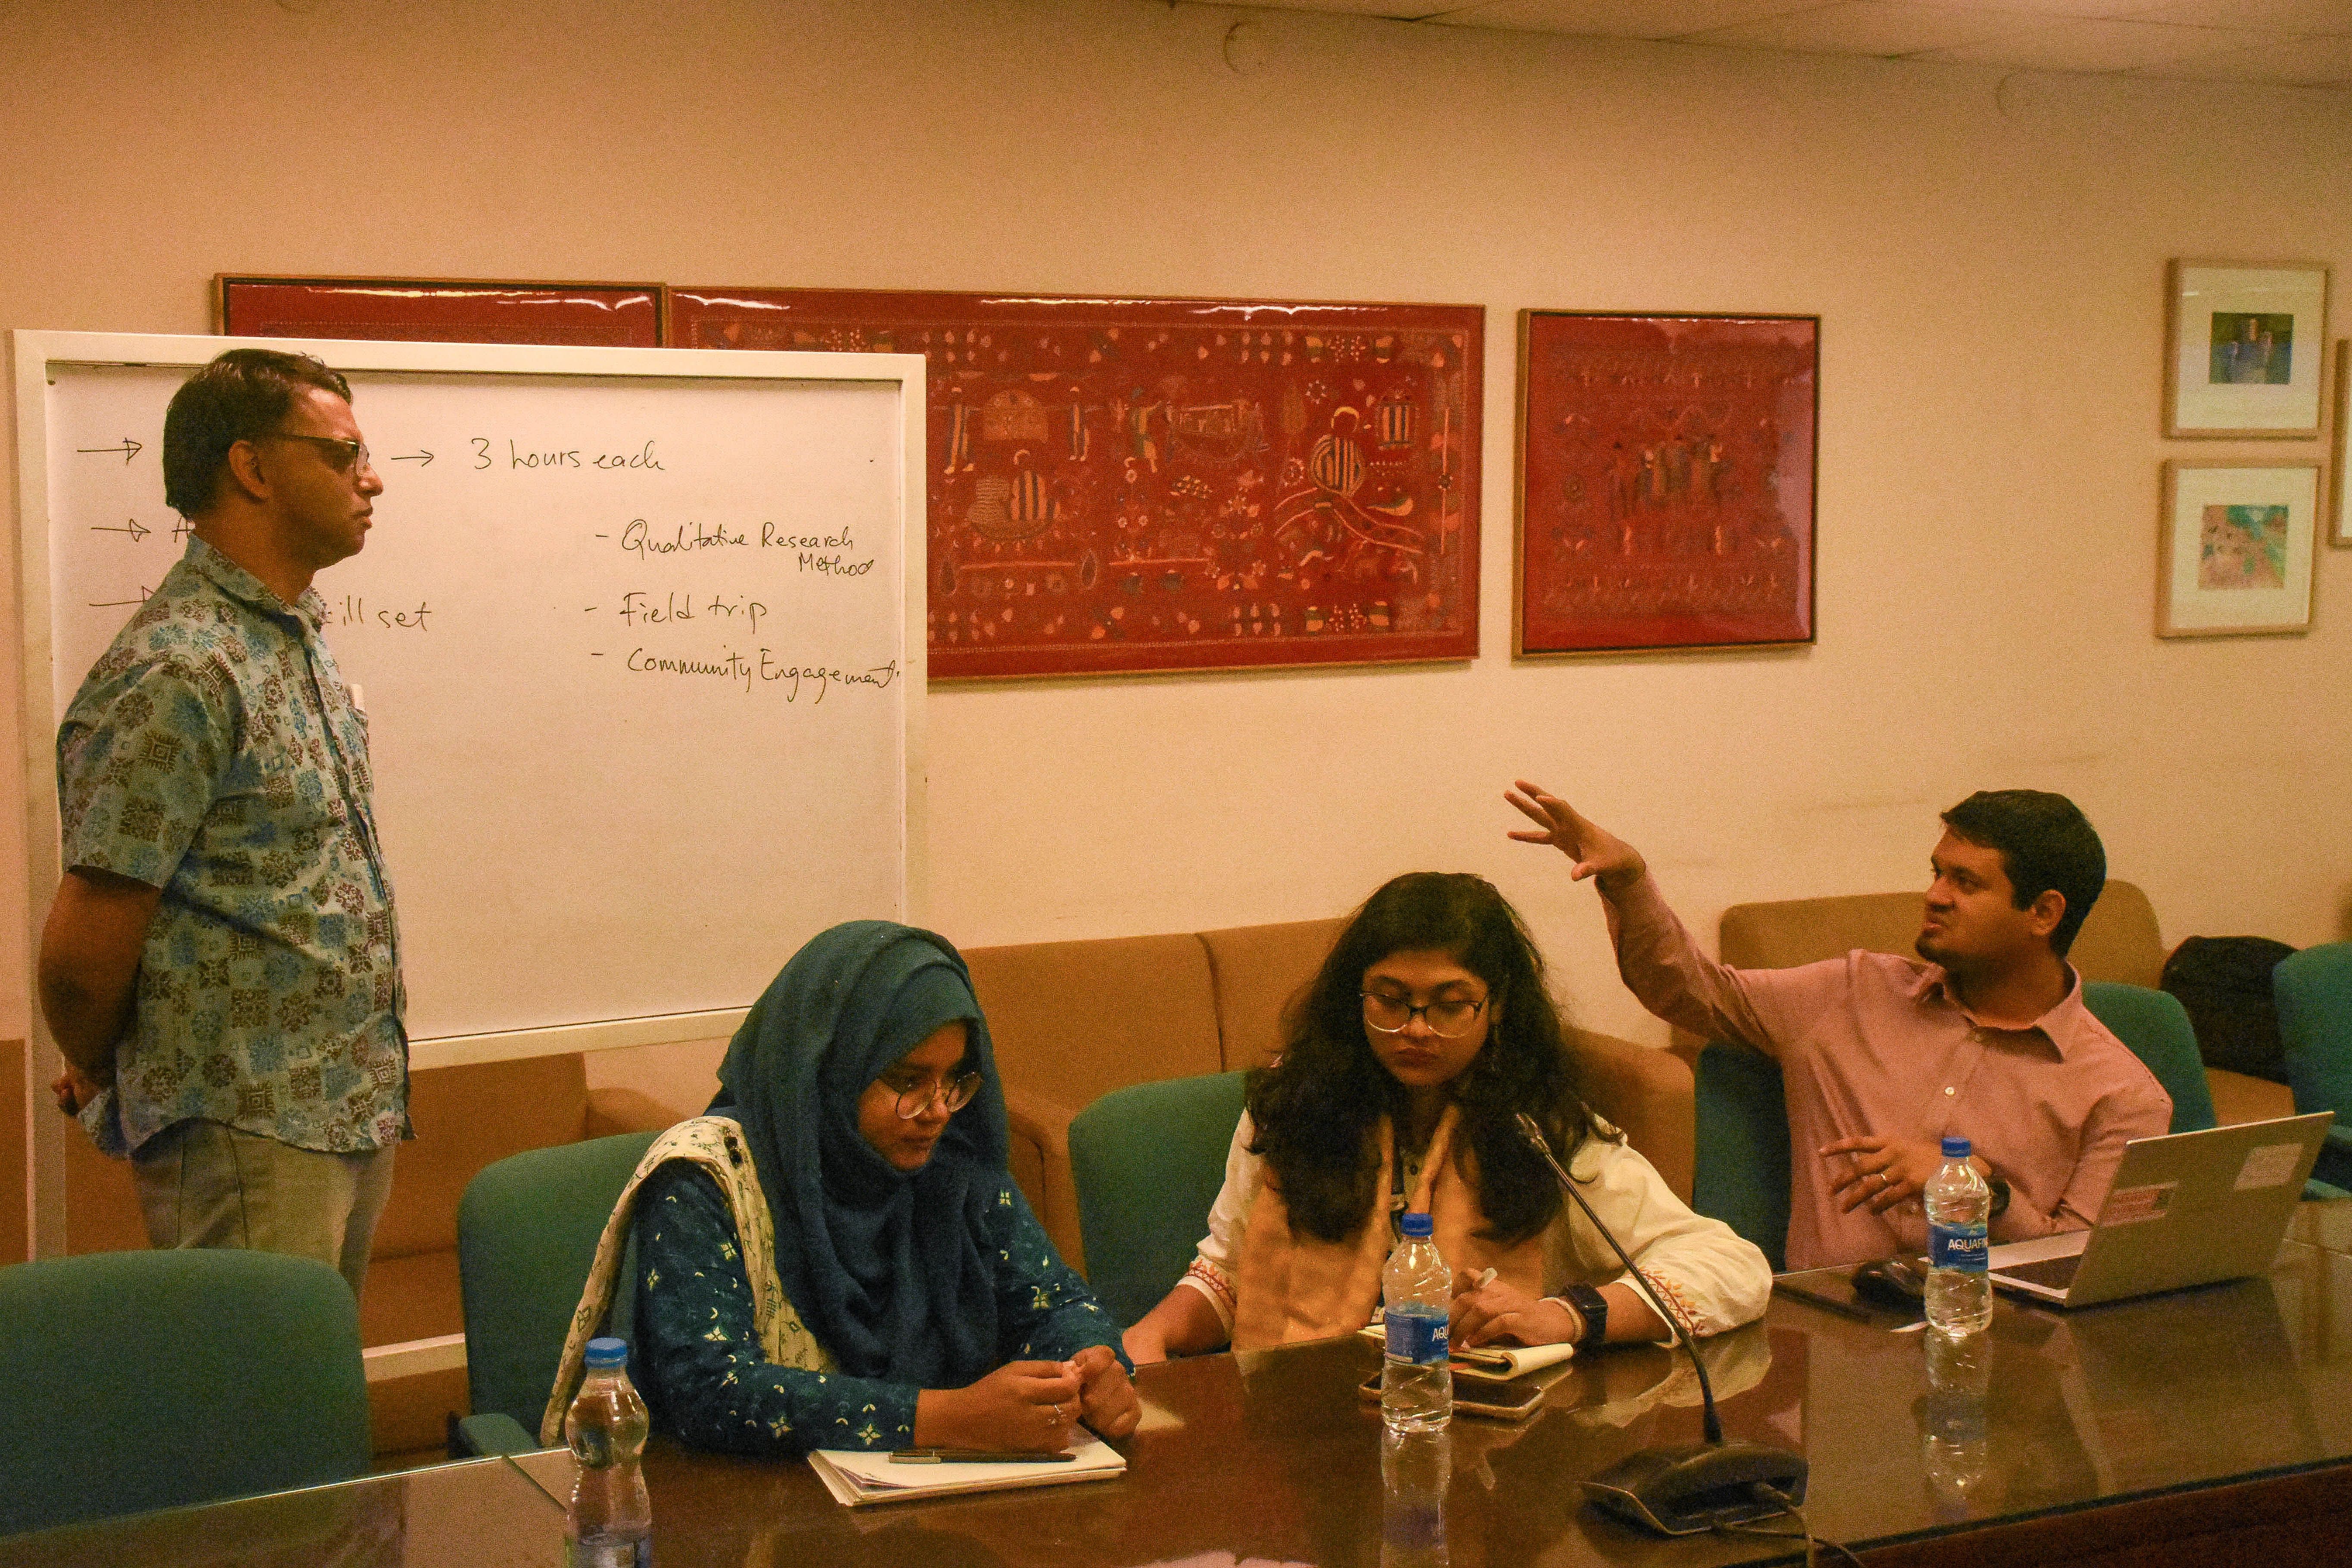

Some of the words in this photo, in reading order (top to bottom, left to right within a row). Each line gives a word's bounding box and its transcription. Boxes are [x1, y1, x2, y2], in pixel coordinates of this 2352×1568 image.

[470, 437, 492, 470] 3
[510, 439, 581, 470] hours
[592, 440, 666, 471] each
[621, 519, 750, 561] Qualitative
[761, 521, 853, 550] Research
[378, 601, 432, 632] set
[619, 591, 695, 627] Field
[707, 595, 767, 635] trip
[627, 644, 751, 693] Community
